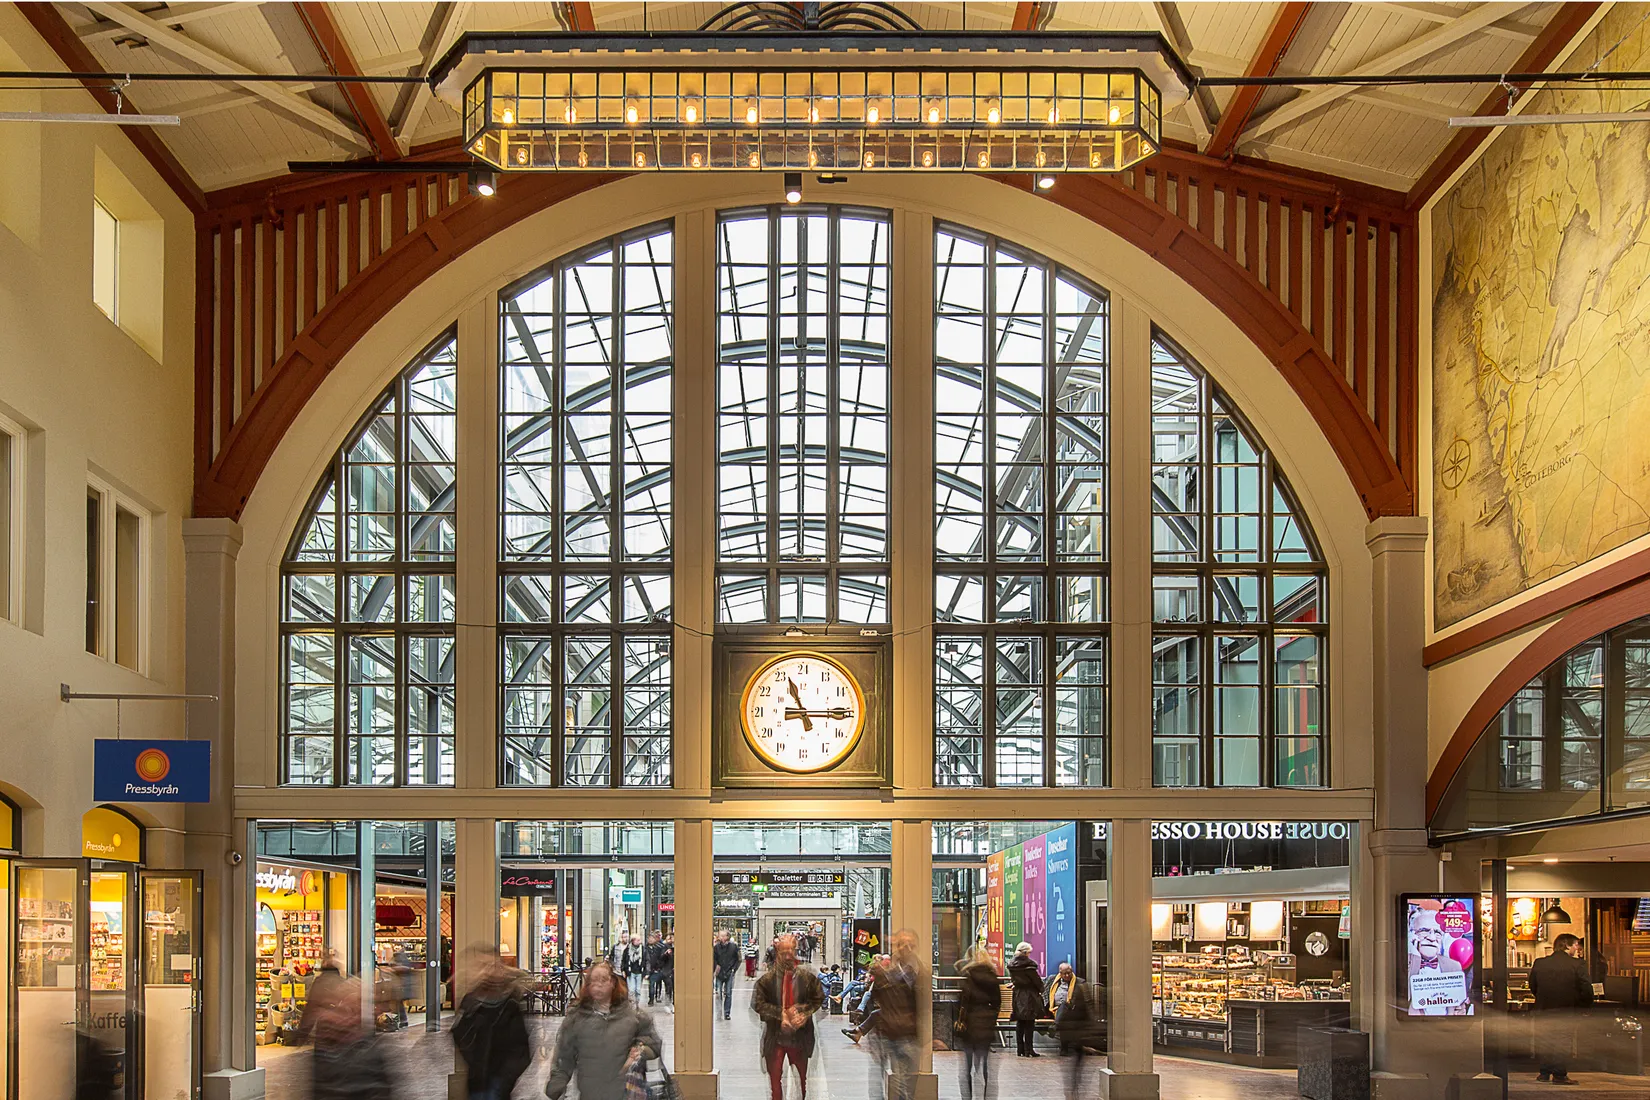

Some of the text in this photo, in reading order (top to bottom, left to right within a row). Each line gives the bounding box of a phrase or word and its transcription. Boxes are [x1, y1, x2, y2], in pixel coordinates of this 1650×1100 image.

[774, 671, 786, 682] 23
[759, 686, 771, 697] 22
[754, 706, 764, 718] 21
[761, 727, 773, 739] 20
[835, 728, 844, 739] 16
[776, 742, 786, 753] 19
[821, 743, 831, 753] 17
[124, 783, 179, 797] Pressbyrån
[1205, 822, 1283, 840] HOUSE
[85, 840, 115, 854] Pressbyrån
[772, 874, 803, 882] Toaletter
[1426, 997, 1454, 1006] hallon
